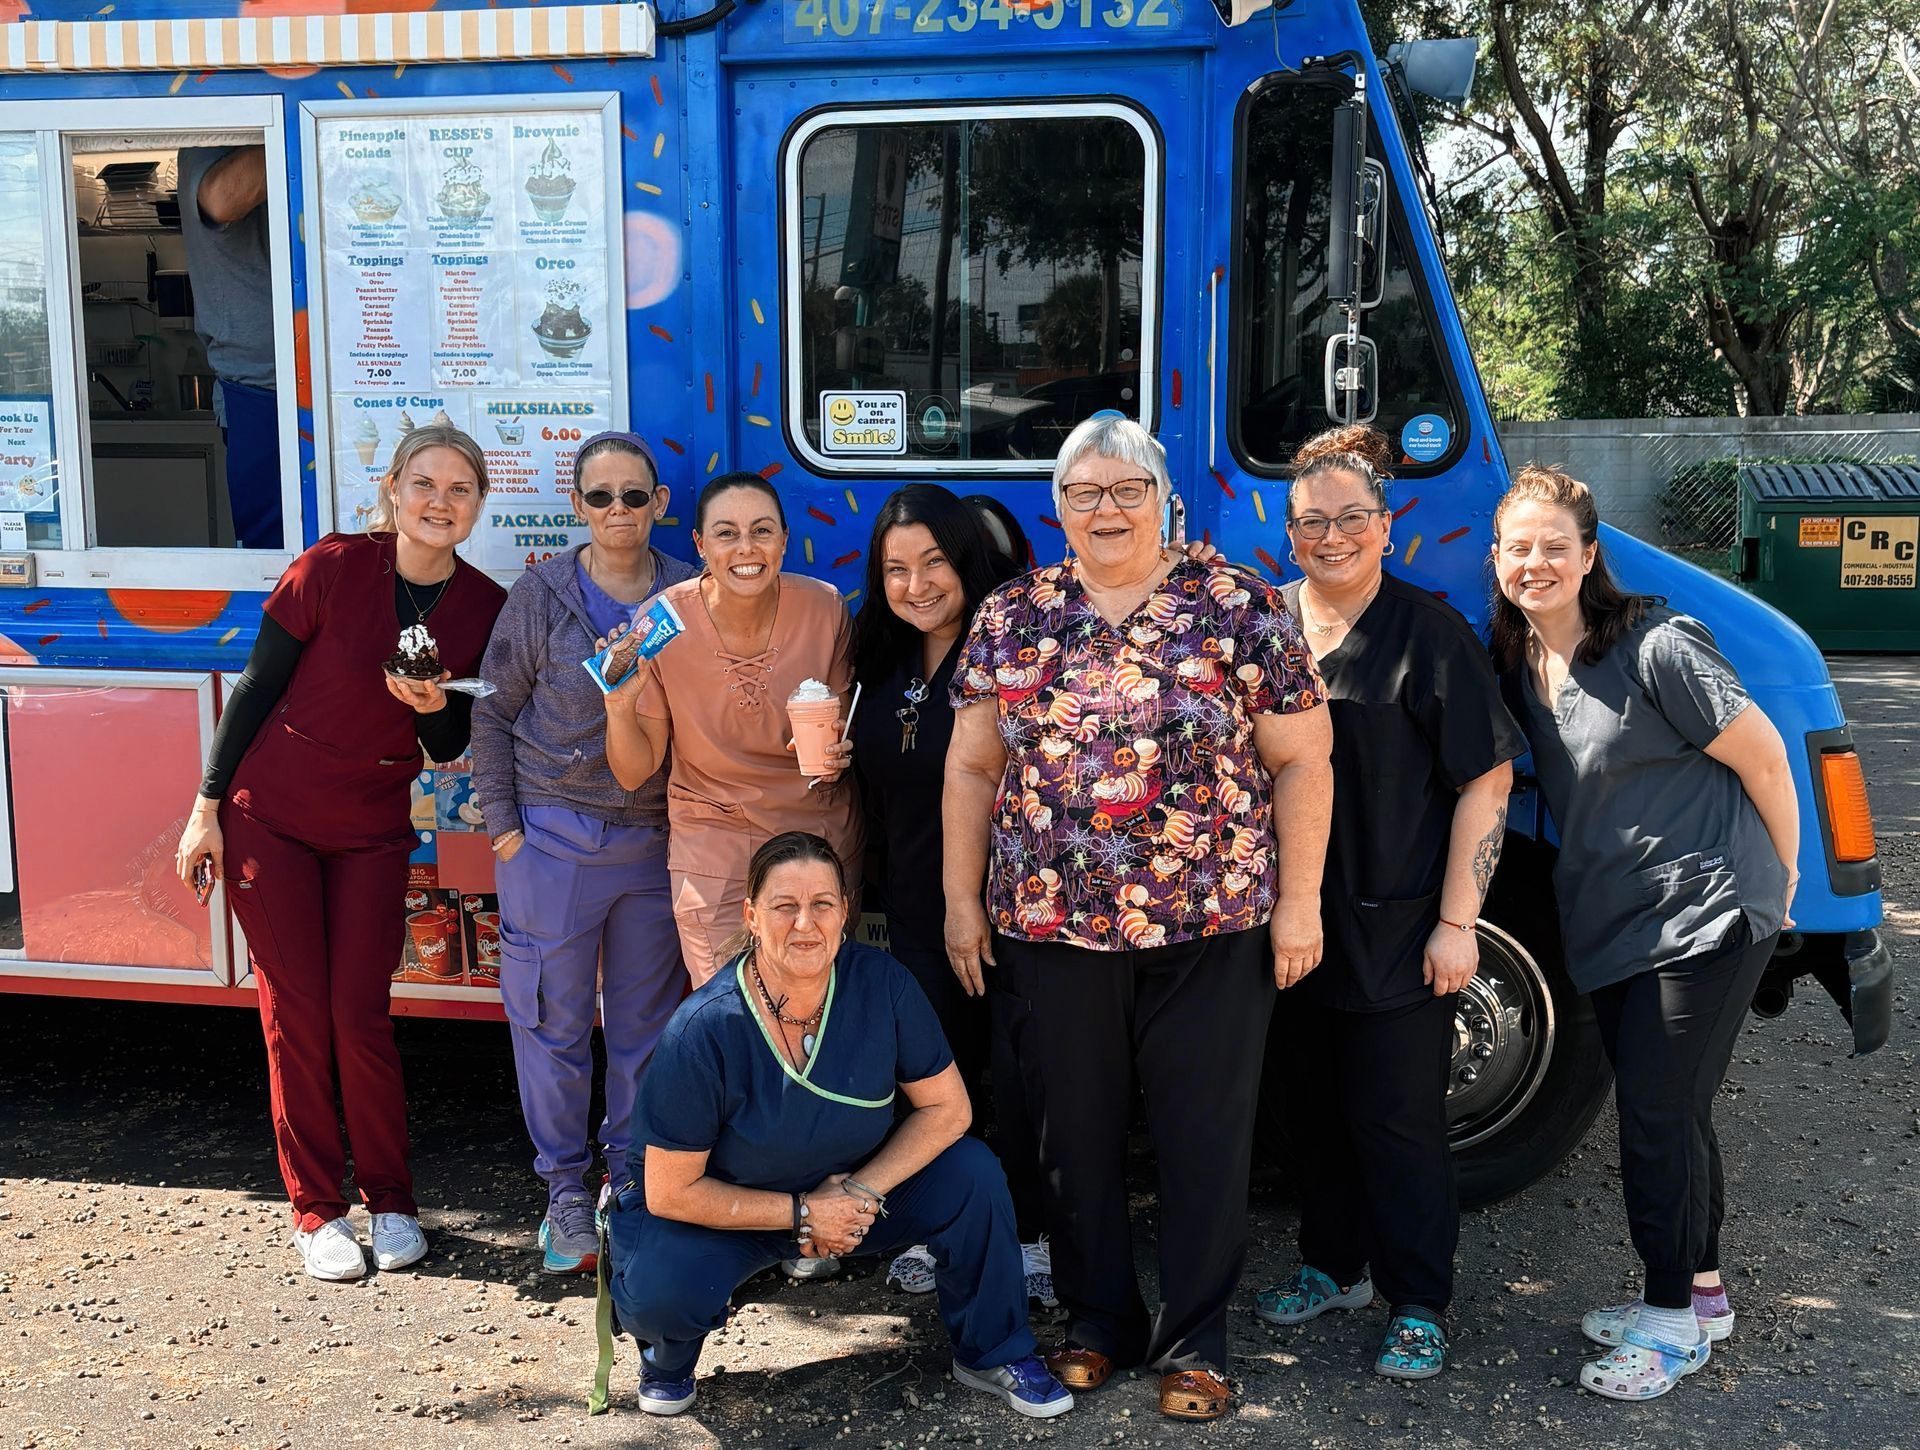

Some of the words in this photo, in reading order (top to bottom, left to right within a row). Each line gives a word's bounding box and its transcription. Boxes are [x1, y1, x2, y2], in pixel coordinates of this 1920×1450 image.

[340, 129, 406, 143] Pineapple
[429, 128, 494, 141] RESSE'S
[513, 125, 580, 139] Brownie
[345, 147, 392, 158] Colada
[443, 147, 473, 158] CUP
[348, 255, 404, 266] Toppings
[431, 254, 488, 266] Toppings
[536, 258, 576, 270] Oreo
[367, 369, 392, 378] 7.00
[452, 369, 477, 378] 7.00
[354, 397, 393, 409] Cones
[396, 397, 407, 408] &
[410, 396, 444, 409] Cups
[488, 402, 594, 415] MILKSHAKES
[856, 400, 877, 408] You
[0, 414, 22, 422] ook
[25, 414, 39, 423] Us
[542, 427, 582, 441] 6.00
[833, 429, 896, 444] Smile!
[514, 534, 568, 546] ITEMS
[1844, 574, 1913, 586] 407-298-8555
